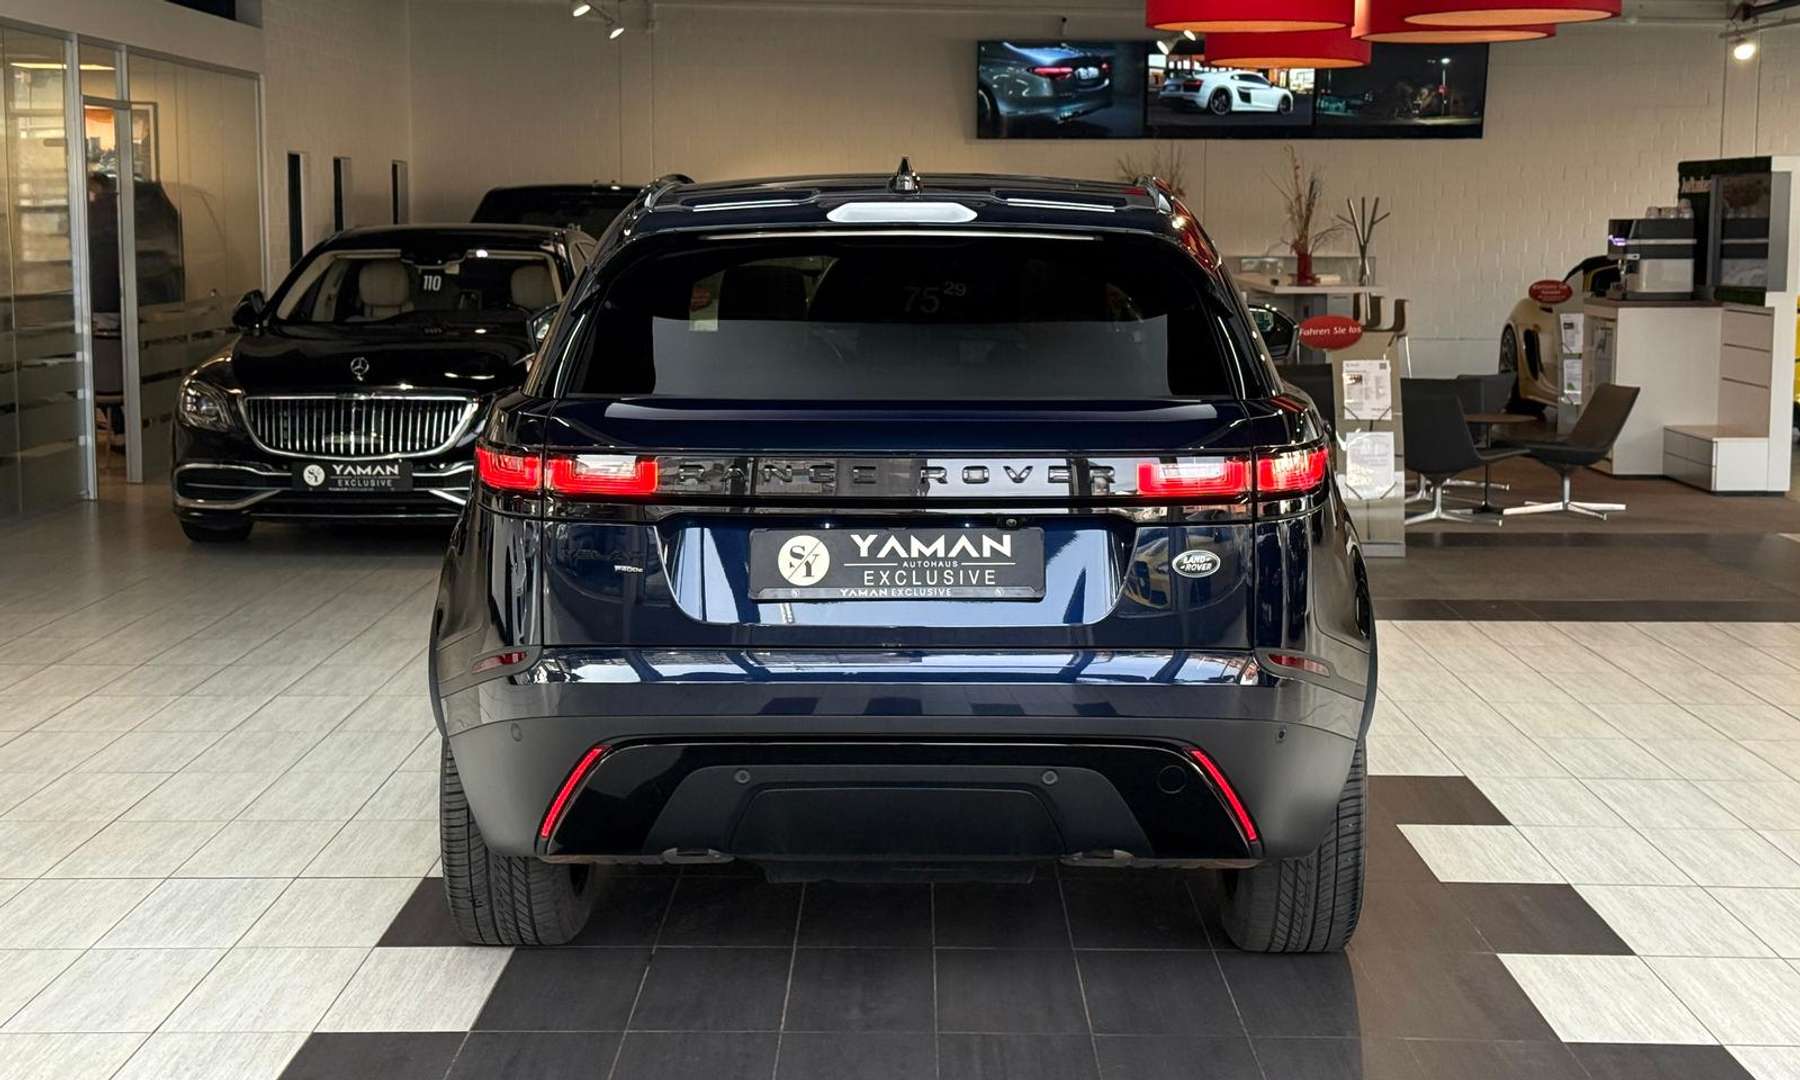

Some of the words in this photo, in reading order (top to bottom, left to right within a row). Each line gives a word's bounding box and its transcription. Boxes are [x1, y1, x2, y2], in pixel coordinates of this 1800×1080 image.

[423, 274, 442, 291] 110
[1299, 328, 1330, 336] Fahren
[1333, 326, 1346, 334] Sie
[332, 464, 399, 475] YAMAN
[678, 464, 878, 484] RANGE
[920, 465, 1116, 484] ROVER
[337, 479, 393, 487] EXCLUSIVE
[850, 534, 1012, 558] YAMAN
[1183, 555, 1206, 563] LAND
[1185, 563, 1212, 571] ROVER
[864, 570, 996, 586] EXCLUSIVE
[840, 588, 888, 597] YAMAN
[891, 588, 951, 597] EXCLUSIVE
